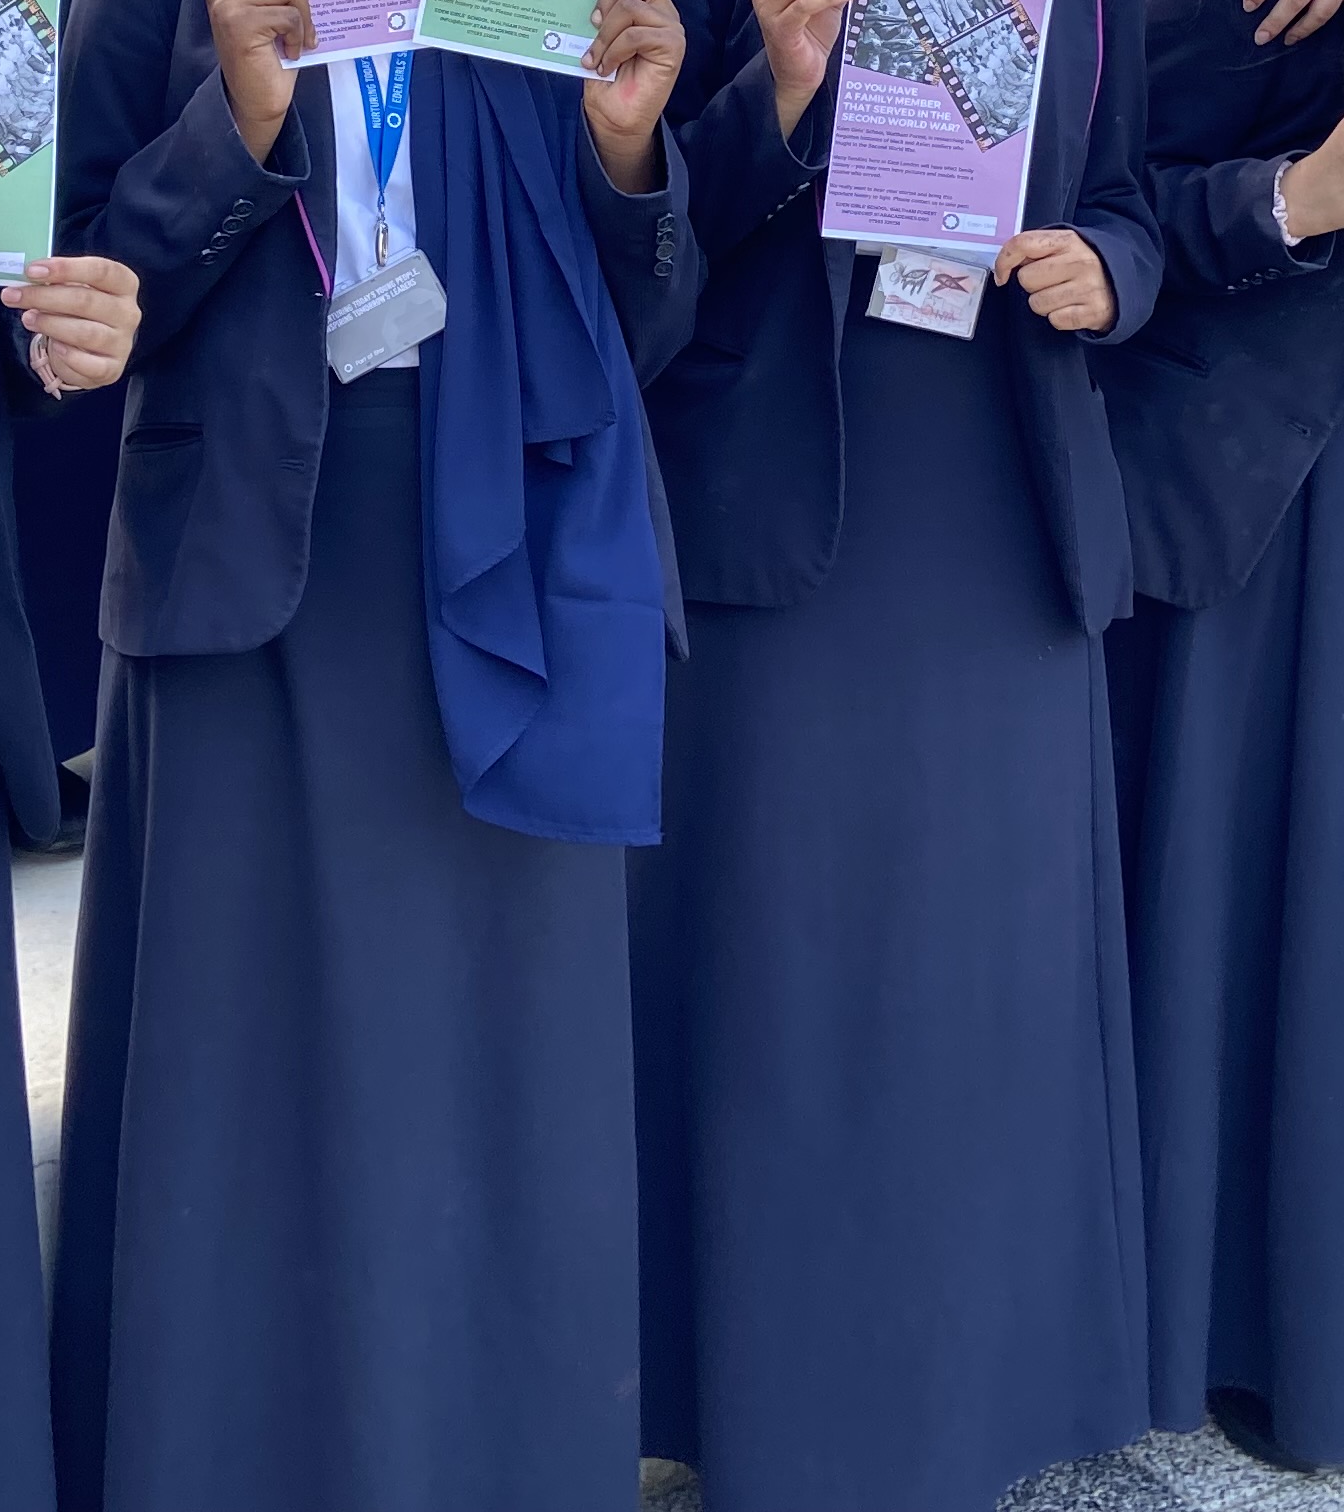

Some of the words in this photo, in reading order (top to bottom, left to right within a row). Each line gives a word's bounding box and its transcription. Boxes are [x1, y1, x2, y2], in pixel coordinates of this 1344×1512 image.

[392, 83, 403, 103] EDEN
[846, 81, 862, 90] DO
[864, 83, 886, 92] YOU
[889, 87, 918, 96] HAVE
[366, 84, 381, 128] NURTURING
[844, 92, 852, 100] A
[855, 93, 894, 104] FAMILY
[895, 98, 941, 109] MEMBER
[843, 102, 872, 112] THAT
[873, 106, 915, 117] SERVED
[918, 110, 928, 118] IN
[930, 111, 951, 121] THE
[842, 113, 886, 125] SECOND
[888, 118, 927, 128] WORLD
[929, 123, 960, 132] WAR?
[376, 280, 396, 295] YOUNG
[390, 278, 416, 297] LEADERS
